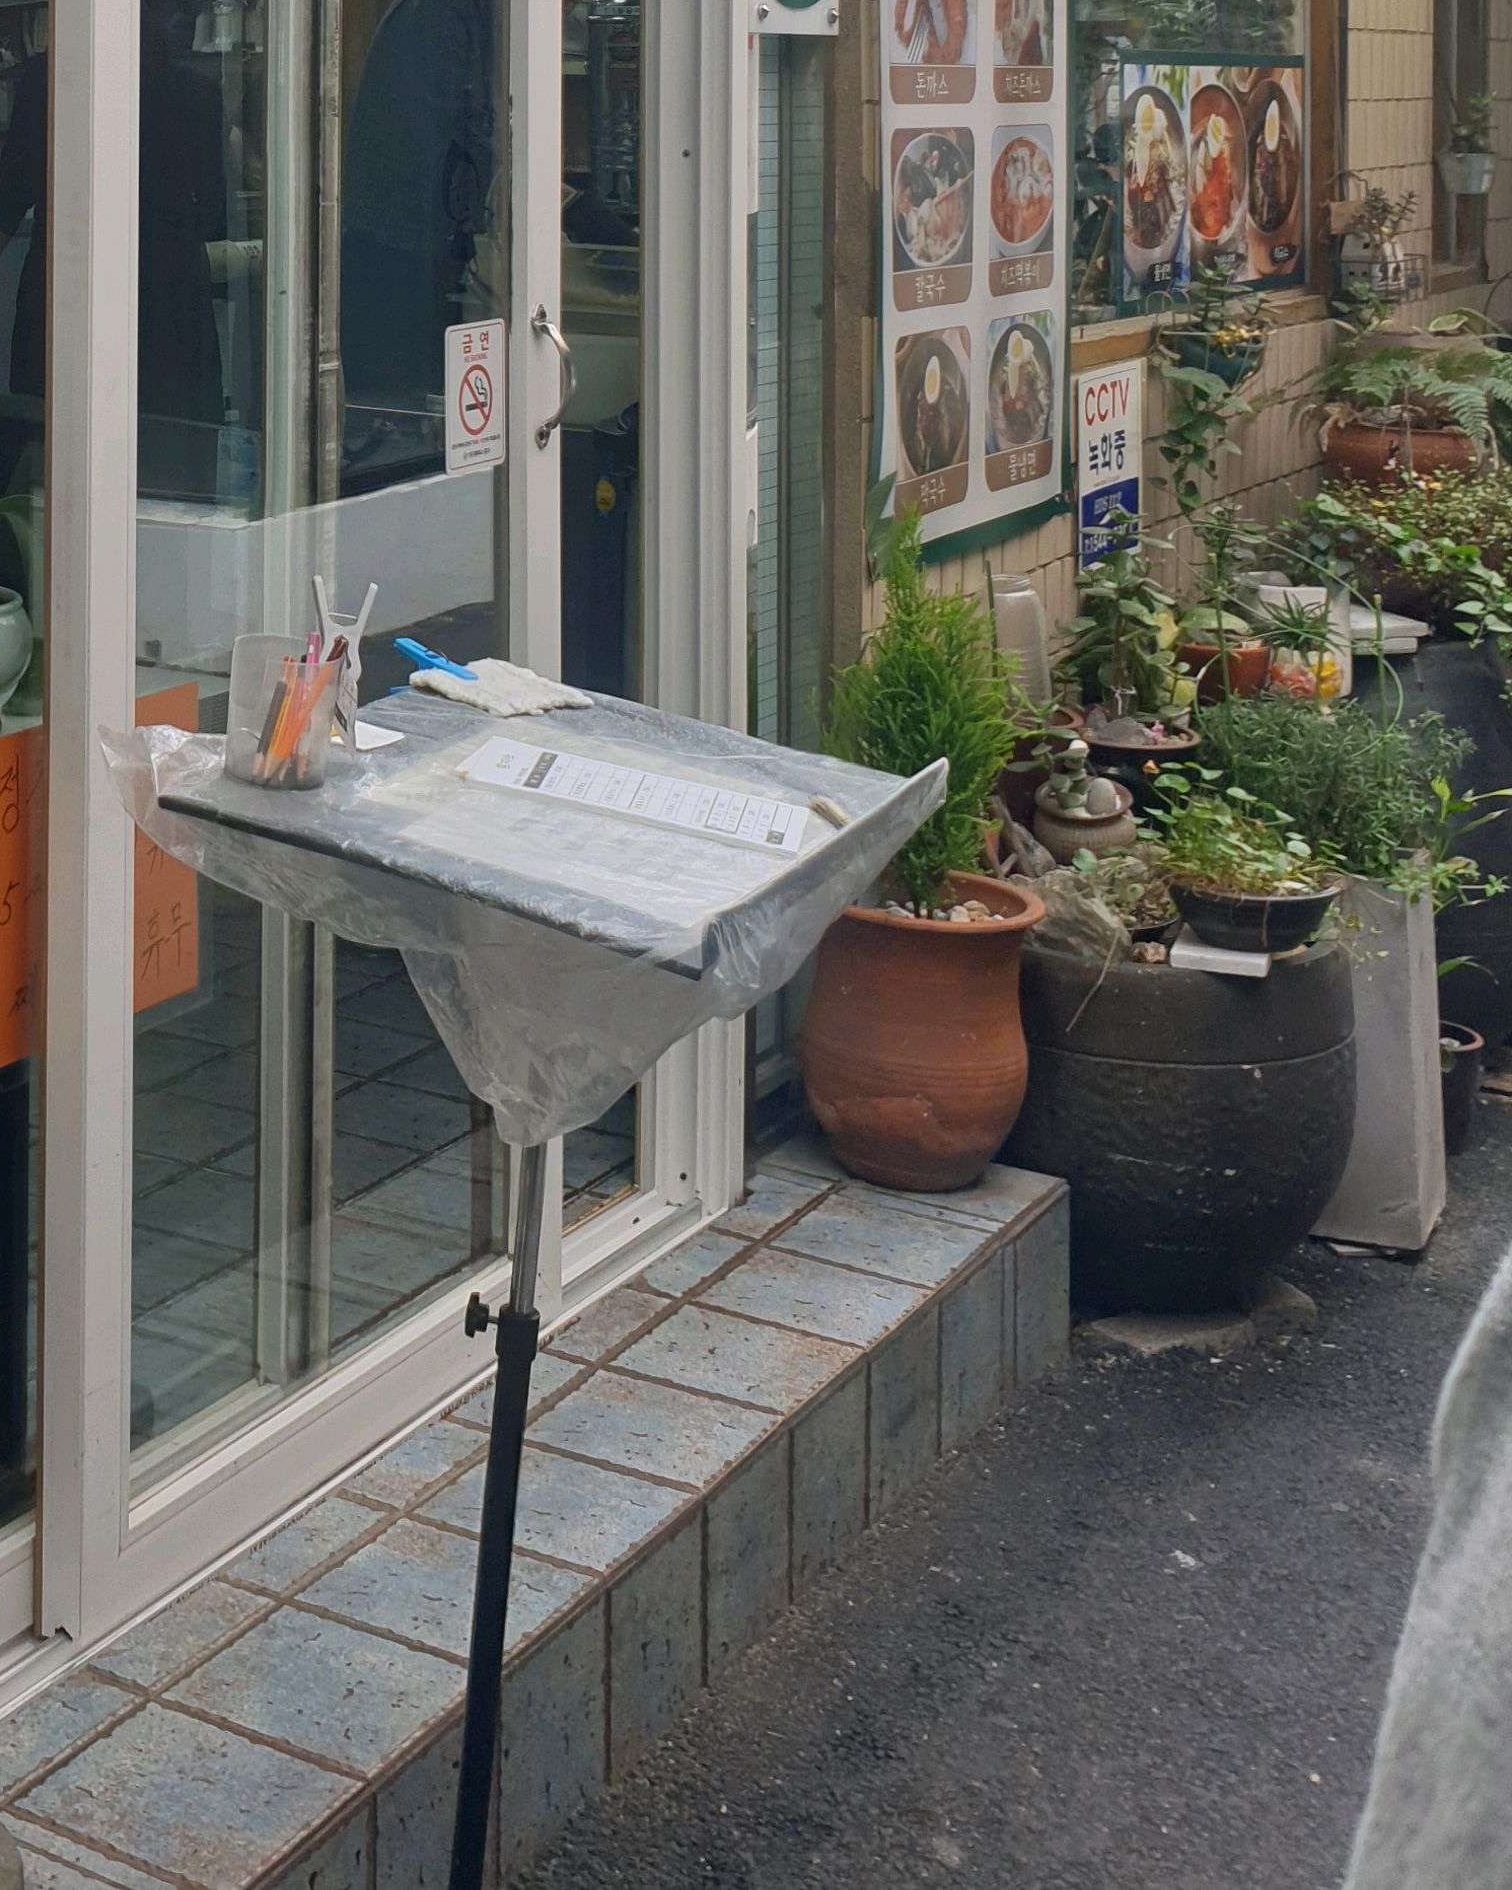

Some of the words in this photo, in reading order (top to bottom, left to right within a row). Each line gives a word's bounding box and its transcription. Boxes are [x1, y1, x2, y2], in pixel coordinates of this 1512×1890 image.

[914, 70, 950, 99] 돈까스
[914, 273, 947, 303] 칼국수
[462, 330, 489, 354] 금연
[1084, 378, 1130, 427] CCTV
[1007, 449, 1038, 482] 물냉면
[1088, 429, 1126, 476] 녹화중
